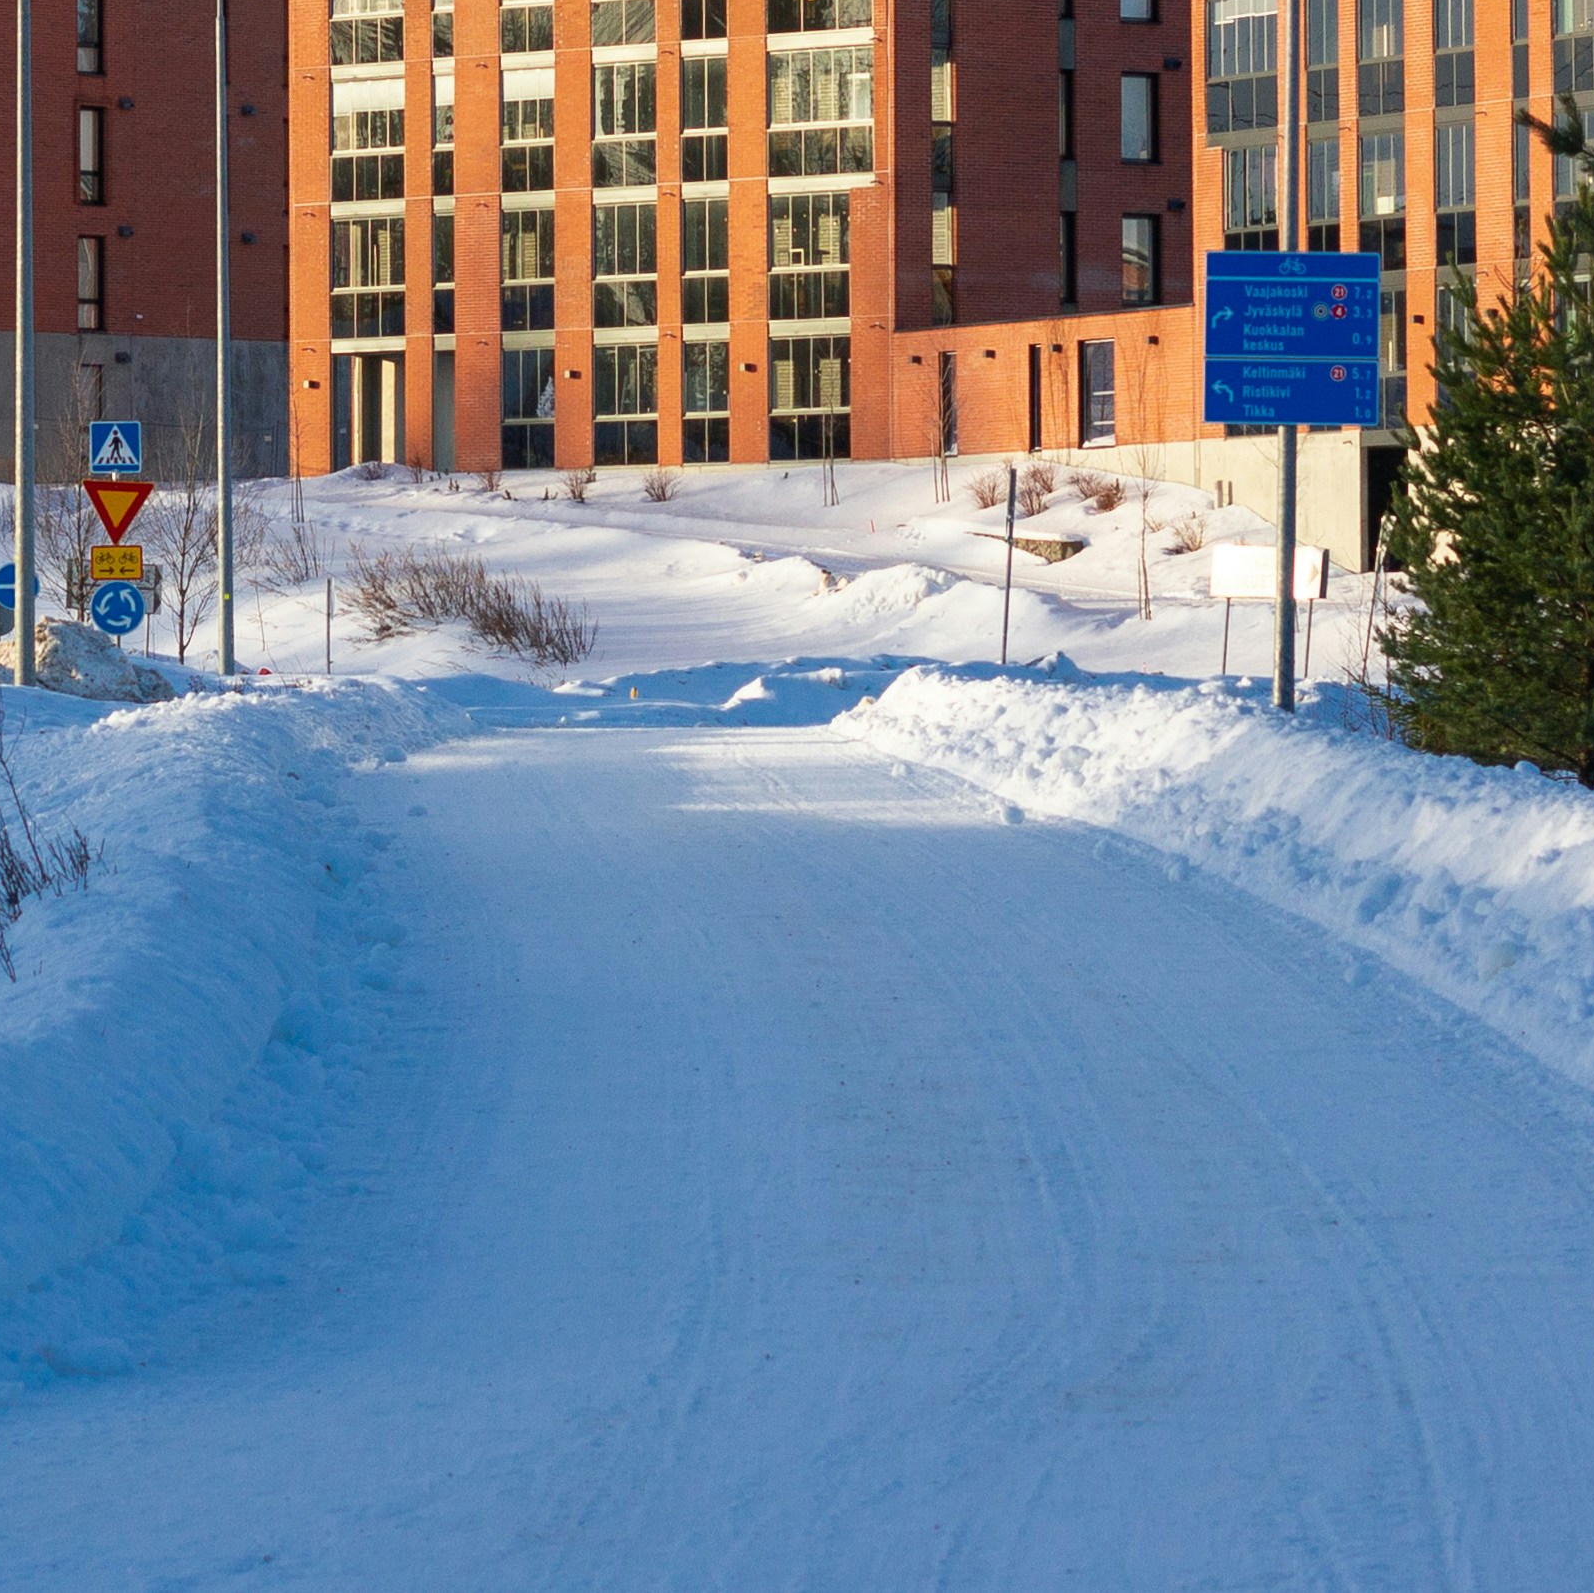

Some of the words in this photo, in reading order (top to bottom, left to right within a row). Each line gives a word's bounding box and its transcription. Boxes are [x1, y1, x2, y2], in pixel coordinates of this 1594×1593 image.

[1244, 285, 1308, 299] Vaajakoski
[1334, 287, 1344, 298] 21
[1243, 304, 1303, 319] Jyväskylä
[1335, 307, 1343, 317] 4
[1243, 323, 1305, 336] Kuokkalan
[1243, 338, 1285, 351] keskus
[1243, 366, 1306, 379] Keltinmäki
[1333, 368, 1343, 378] 21
[1242, 385, 1291, 398] Ristikivi
[1243, 404, 1275, 417] Tikka
